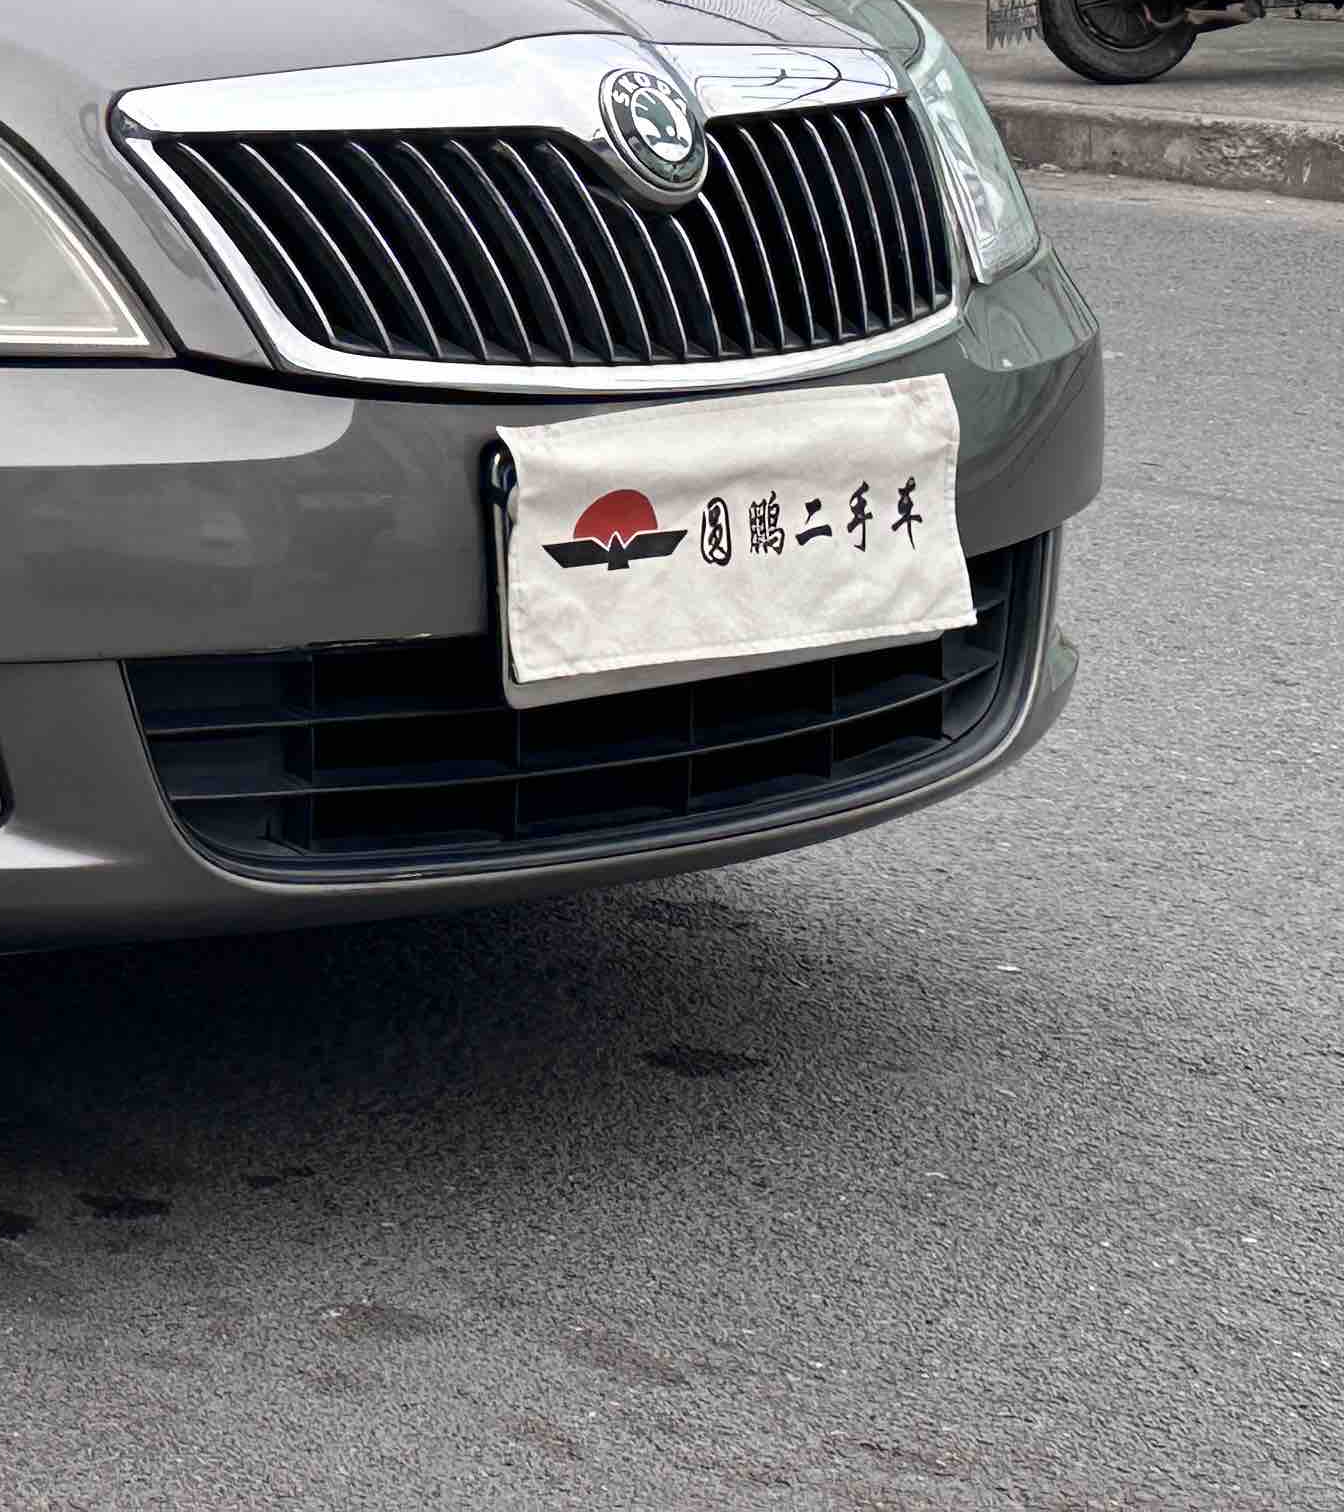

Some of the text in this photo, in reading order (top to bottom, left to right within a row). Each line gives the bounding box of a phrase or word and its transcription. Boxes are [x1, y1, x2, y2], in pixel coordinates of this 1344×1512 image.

[701, 476, 923, 566] 圆鹏二手车
